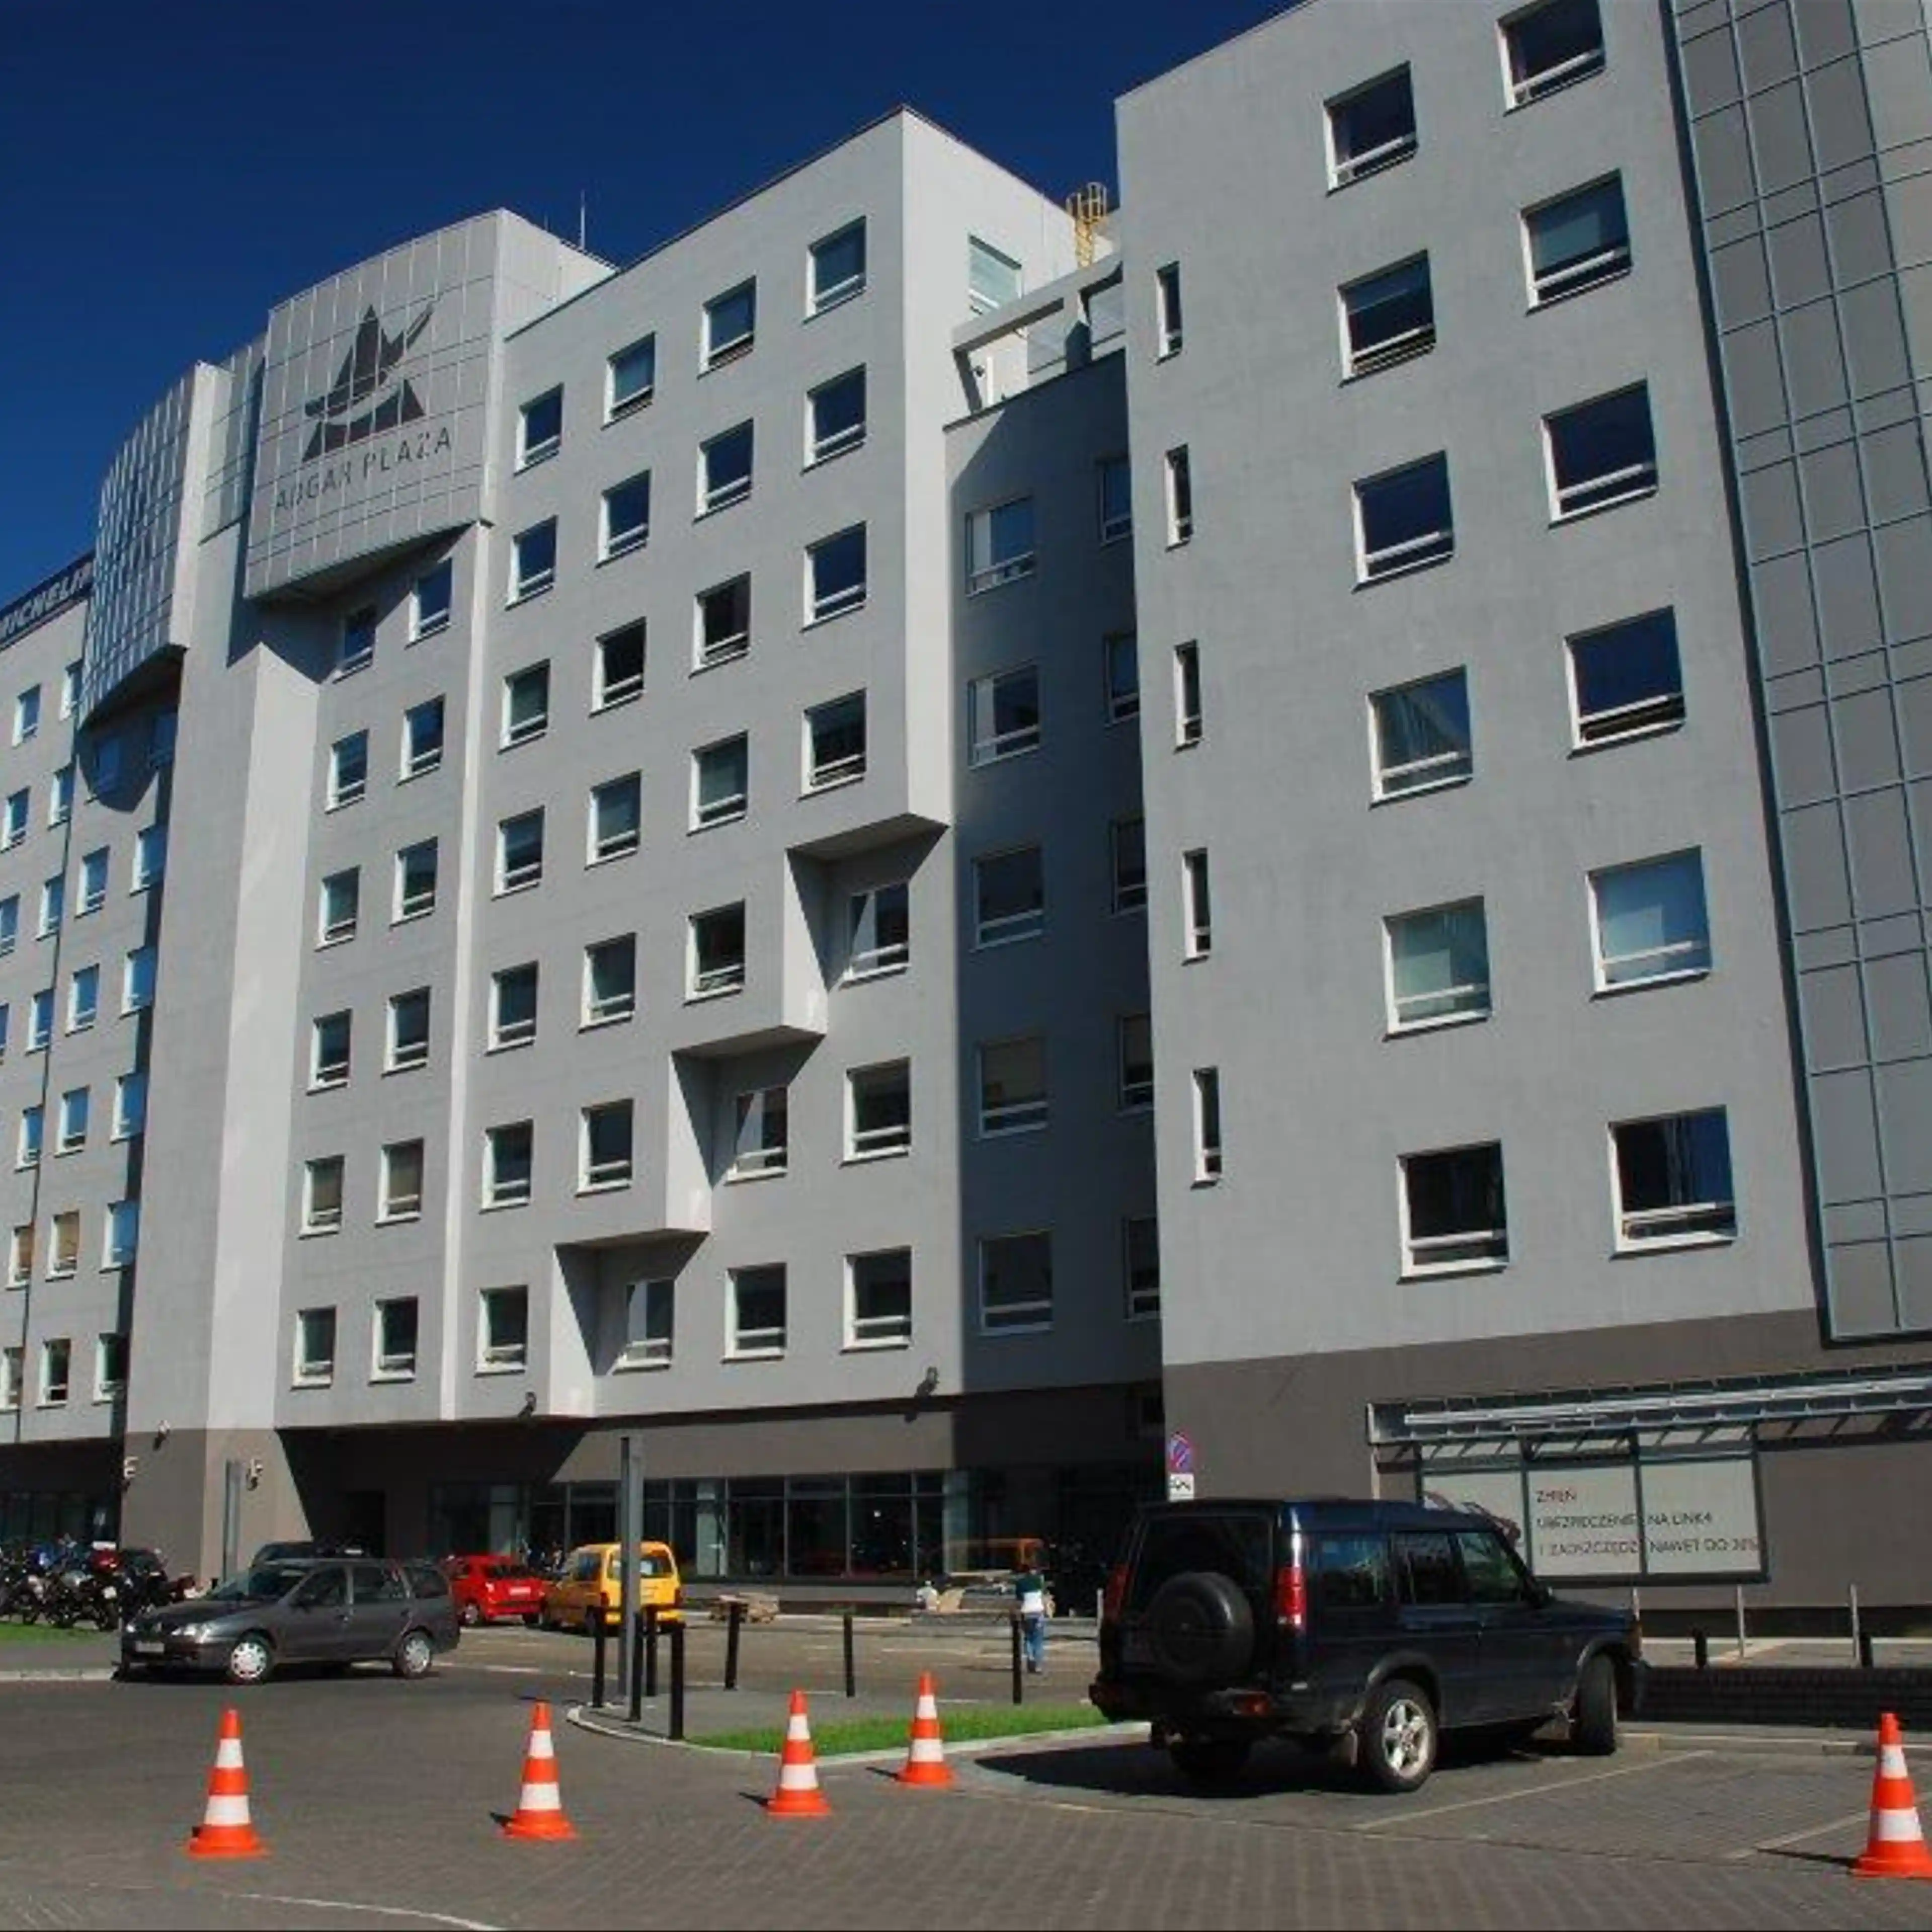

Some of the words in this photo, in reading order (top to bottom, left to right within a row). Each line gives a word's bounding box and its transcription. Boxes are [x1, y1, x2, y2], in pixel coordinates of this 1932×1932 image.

[363, 426, 452, 478] PLAZA
[1648, 1513, 1670, 1526] NA
[1649, 1537, 1699, 1553] NAWET
[1704, 1538, 1728, 1551] DO
